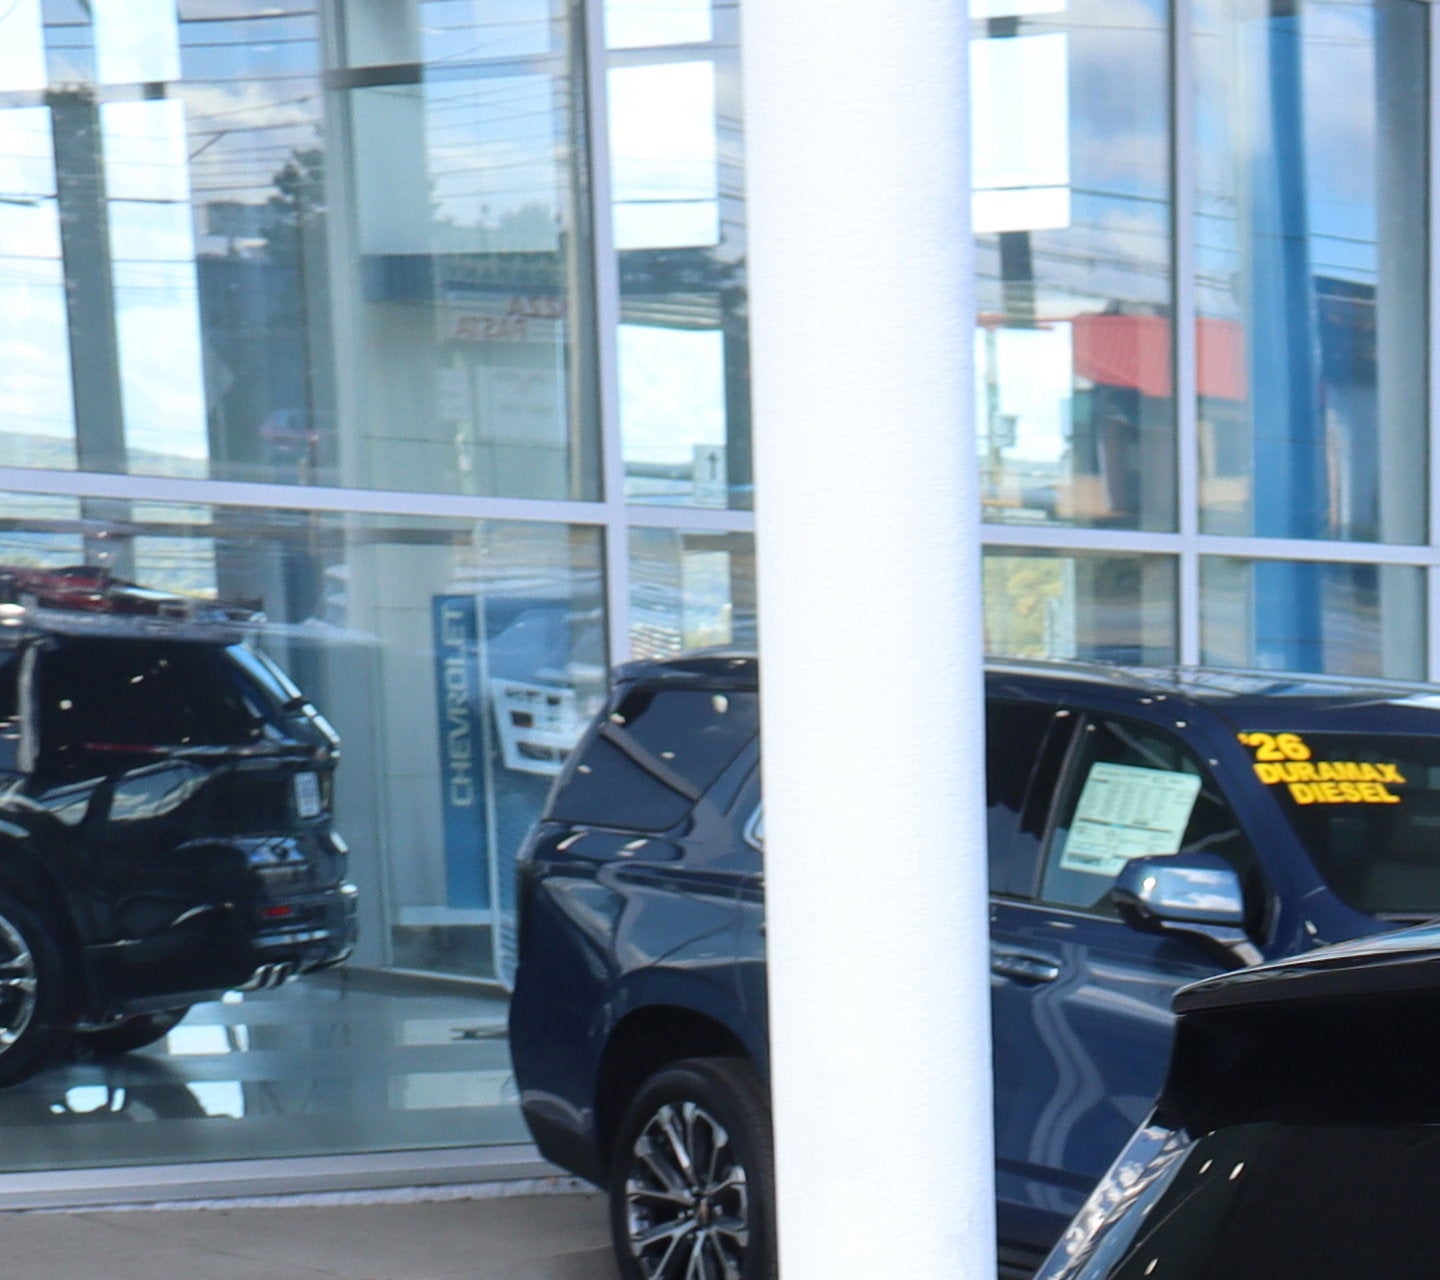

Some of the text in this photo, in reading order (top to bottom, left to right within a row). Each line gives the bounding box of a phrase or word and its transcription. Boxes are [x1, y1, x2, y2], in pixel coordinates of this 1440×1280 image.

[441, 604, 475, 808] CHEVROLET
[1252, 761, 1407, 785] DURAMAX
[1287, 782, 1402, 805] DIESEL
